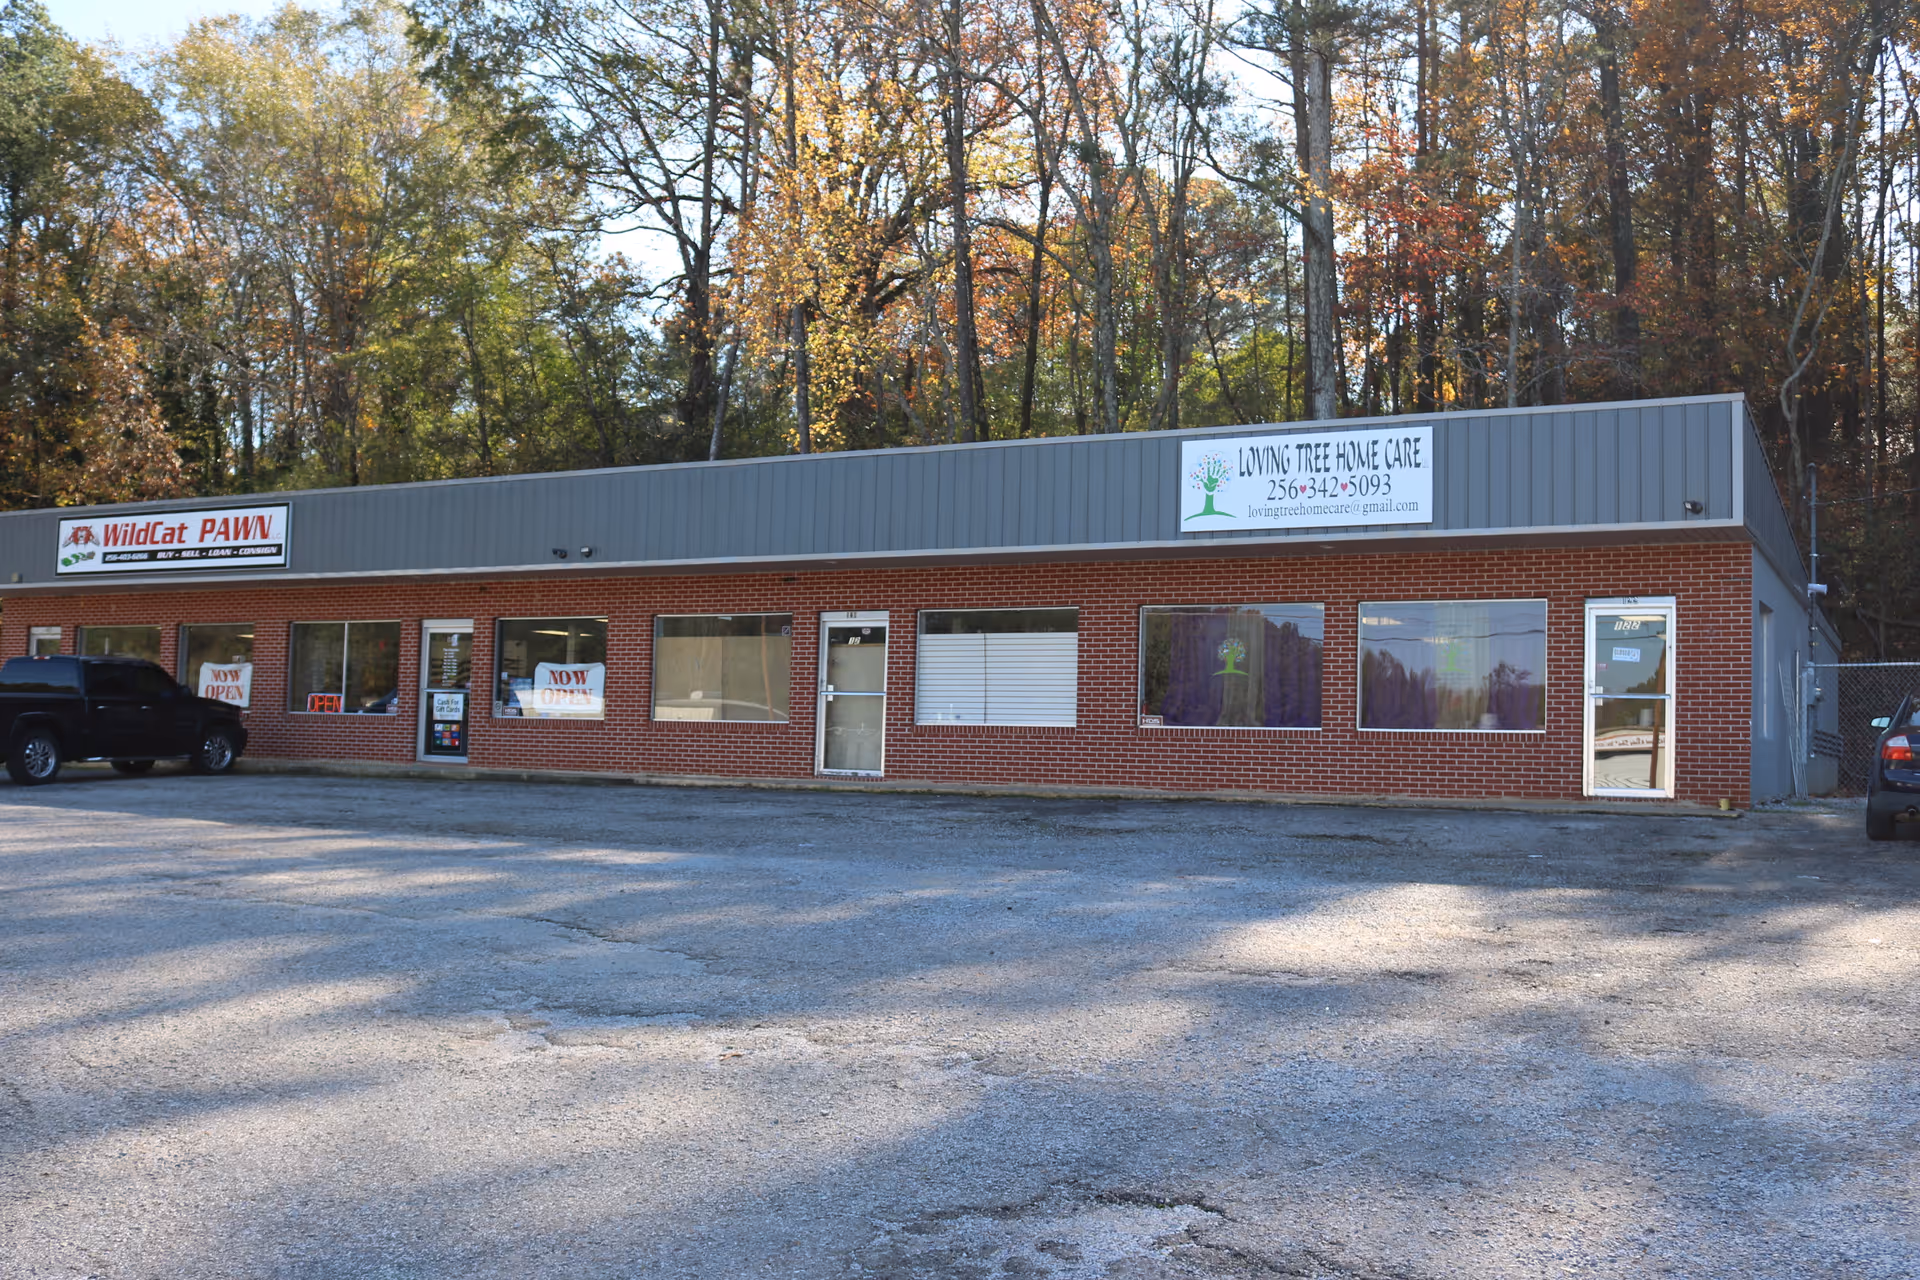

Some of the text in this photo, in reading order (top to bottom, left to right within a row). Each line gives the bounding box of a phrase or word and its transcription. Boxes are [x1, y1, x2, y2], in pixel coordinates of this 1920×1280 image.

[1239, 437, 1421, 477] LOVING TREE HOME CARE
[1267, 473, 1391, 501] 256 342 5093
[1248, 498, 1419, 519] lovingtreehomecare@gmail.com
[103, 521, 188, 547] WildCat
[198, 515, 272, 543] PAWN
[156, 551, 175, 559] BUY
[180, 549, 200, 558] SELL
[208, 548, 232, 557] LOAN
[239, 546, 278, 555] CONSIGN
[1614, 621, 1640, 631] 122
[211, 669, 242, 682] NOW
[548, 669, 590, 686] NOW
[205, 684, 243, 700] OPEN
[541, 687, 593, 706] OPEN
[308, 694, 343, 713] OPEN
